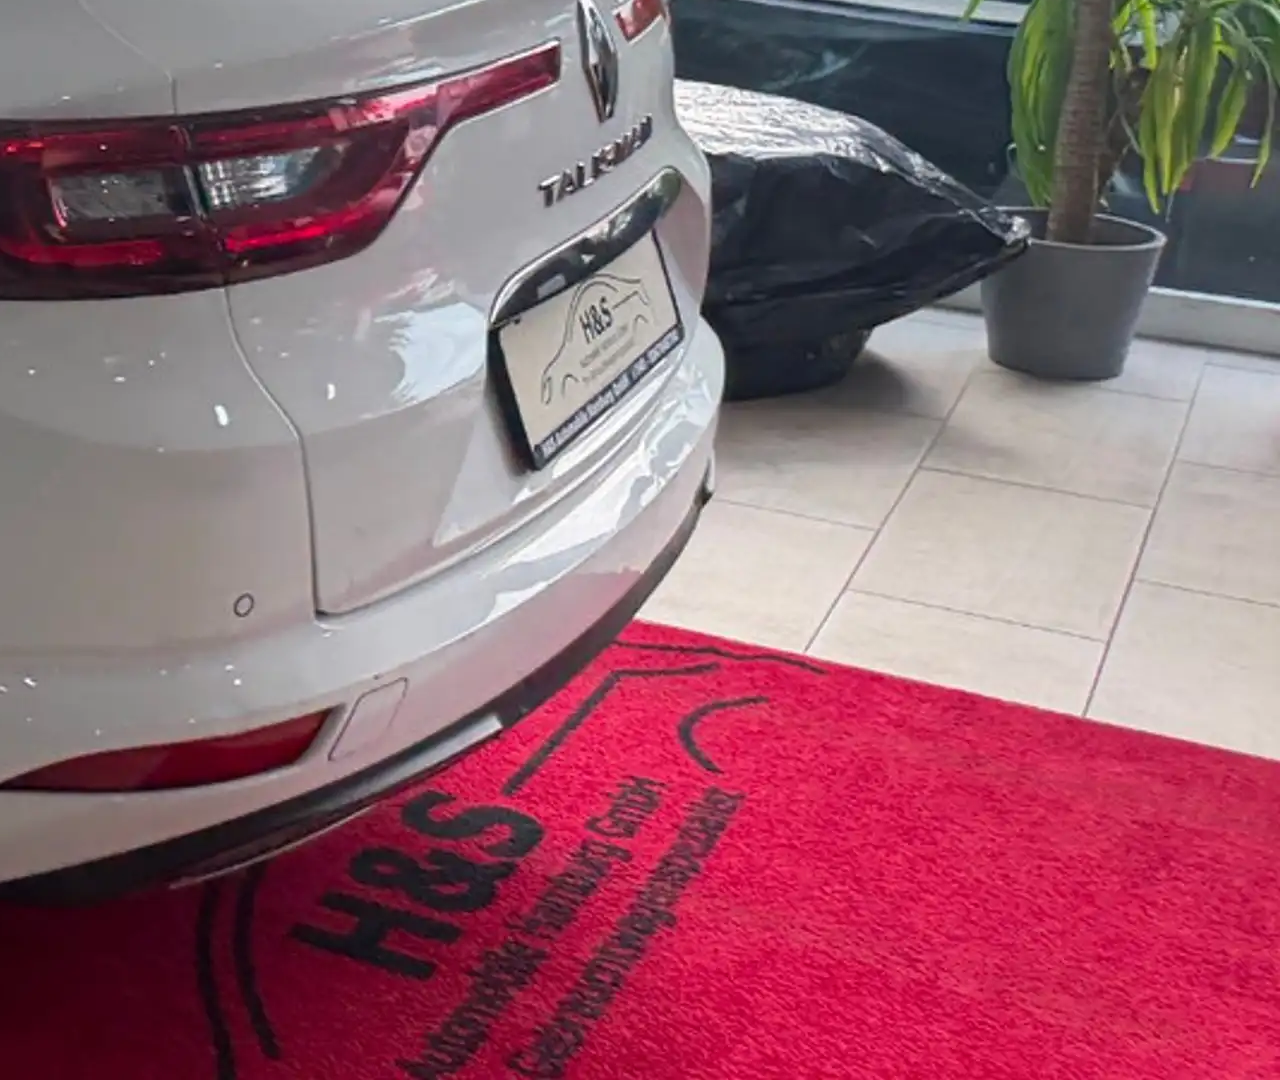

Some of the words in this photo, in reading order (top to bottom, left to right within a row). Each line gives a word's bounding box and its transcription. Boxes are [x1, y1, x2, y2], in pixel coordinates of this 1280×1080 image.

[538, 113, 653, 208] TALISMAN
[579, 295, 613, 344] H&S
[586, 776, 668, 840] GmbH
[291, 789, 547, 981] H&S
